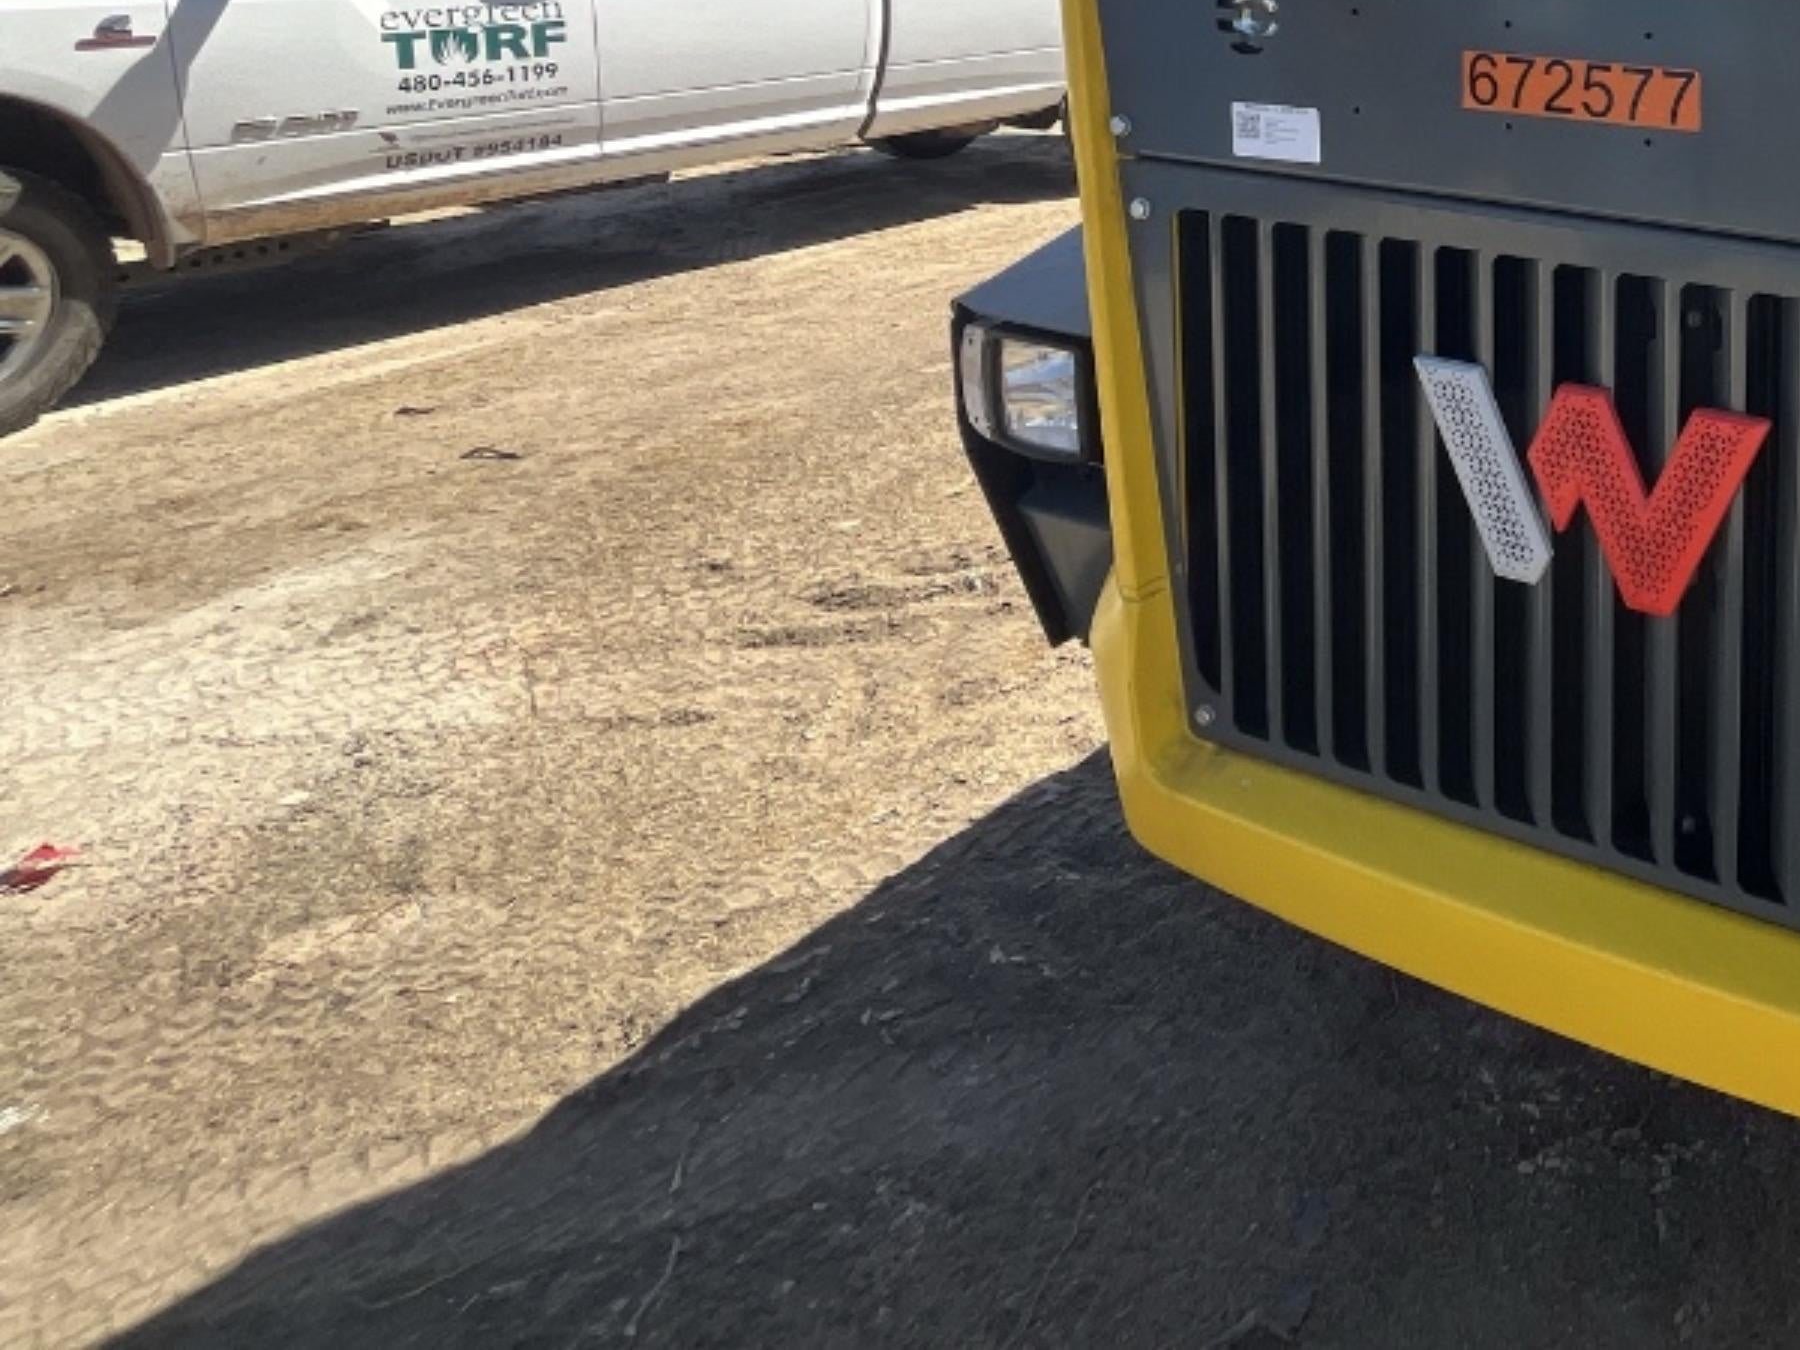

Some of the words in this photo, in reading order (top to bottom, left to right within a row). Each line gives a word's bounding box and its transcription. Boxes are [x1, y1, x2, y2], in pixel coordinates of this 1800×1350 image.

[381, 21, 567, 70] TURF
[398, 62, 558, 93] 480-456-1199
[1469, 53, 1696, 126] 672577
